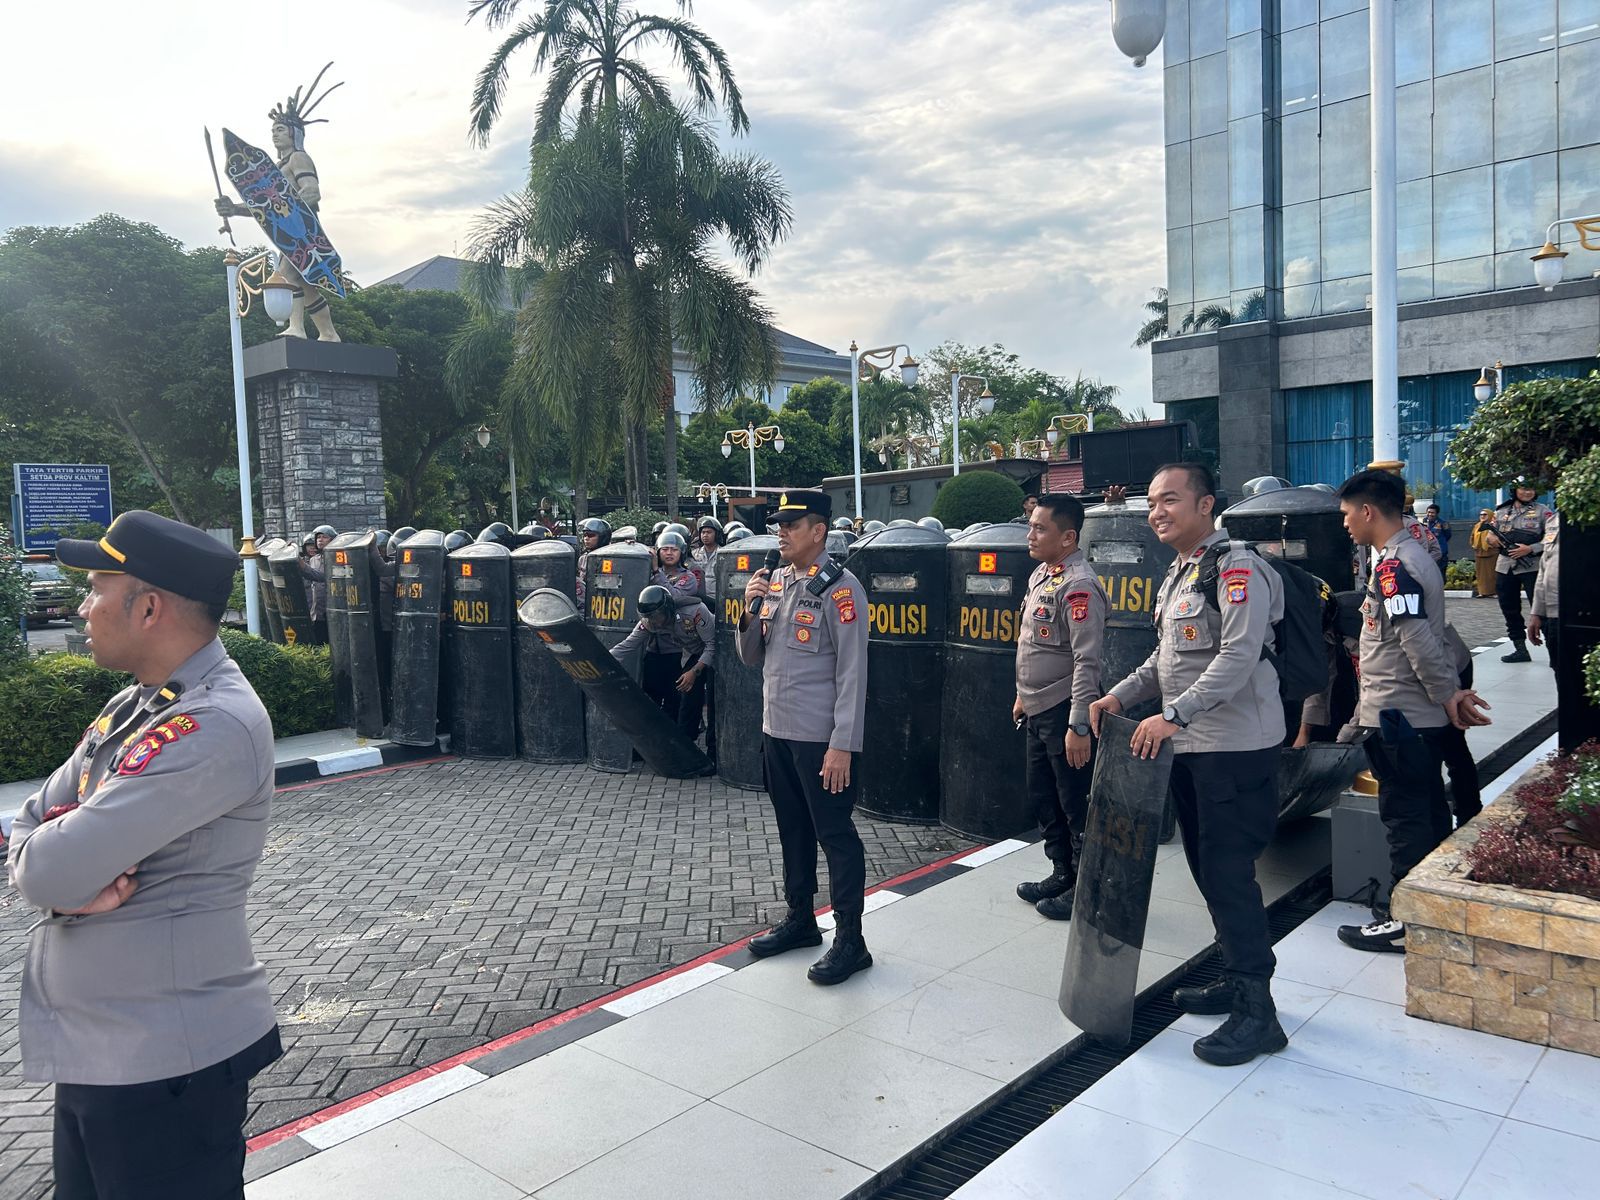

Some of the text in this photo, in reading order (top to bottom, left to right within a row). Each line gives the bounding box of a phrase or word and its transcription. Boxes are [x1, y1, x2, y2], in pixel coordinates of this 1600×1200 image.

[403, 550, 412, 563] B
[738, 556, 749, 570] B
[981, 555, 995, 571] B
[462, 563, 472, 576] B
[602, 560, 612, 573] B
[453, 600, 489, 623] POLISI
[591, 595, 625, 620] POLISI
[798, 600, 822, 609] POLRI
[867, 603, 926, 634] POLISI
[960, 606, 1021, 642] POLISI
